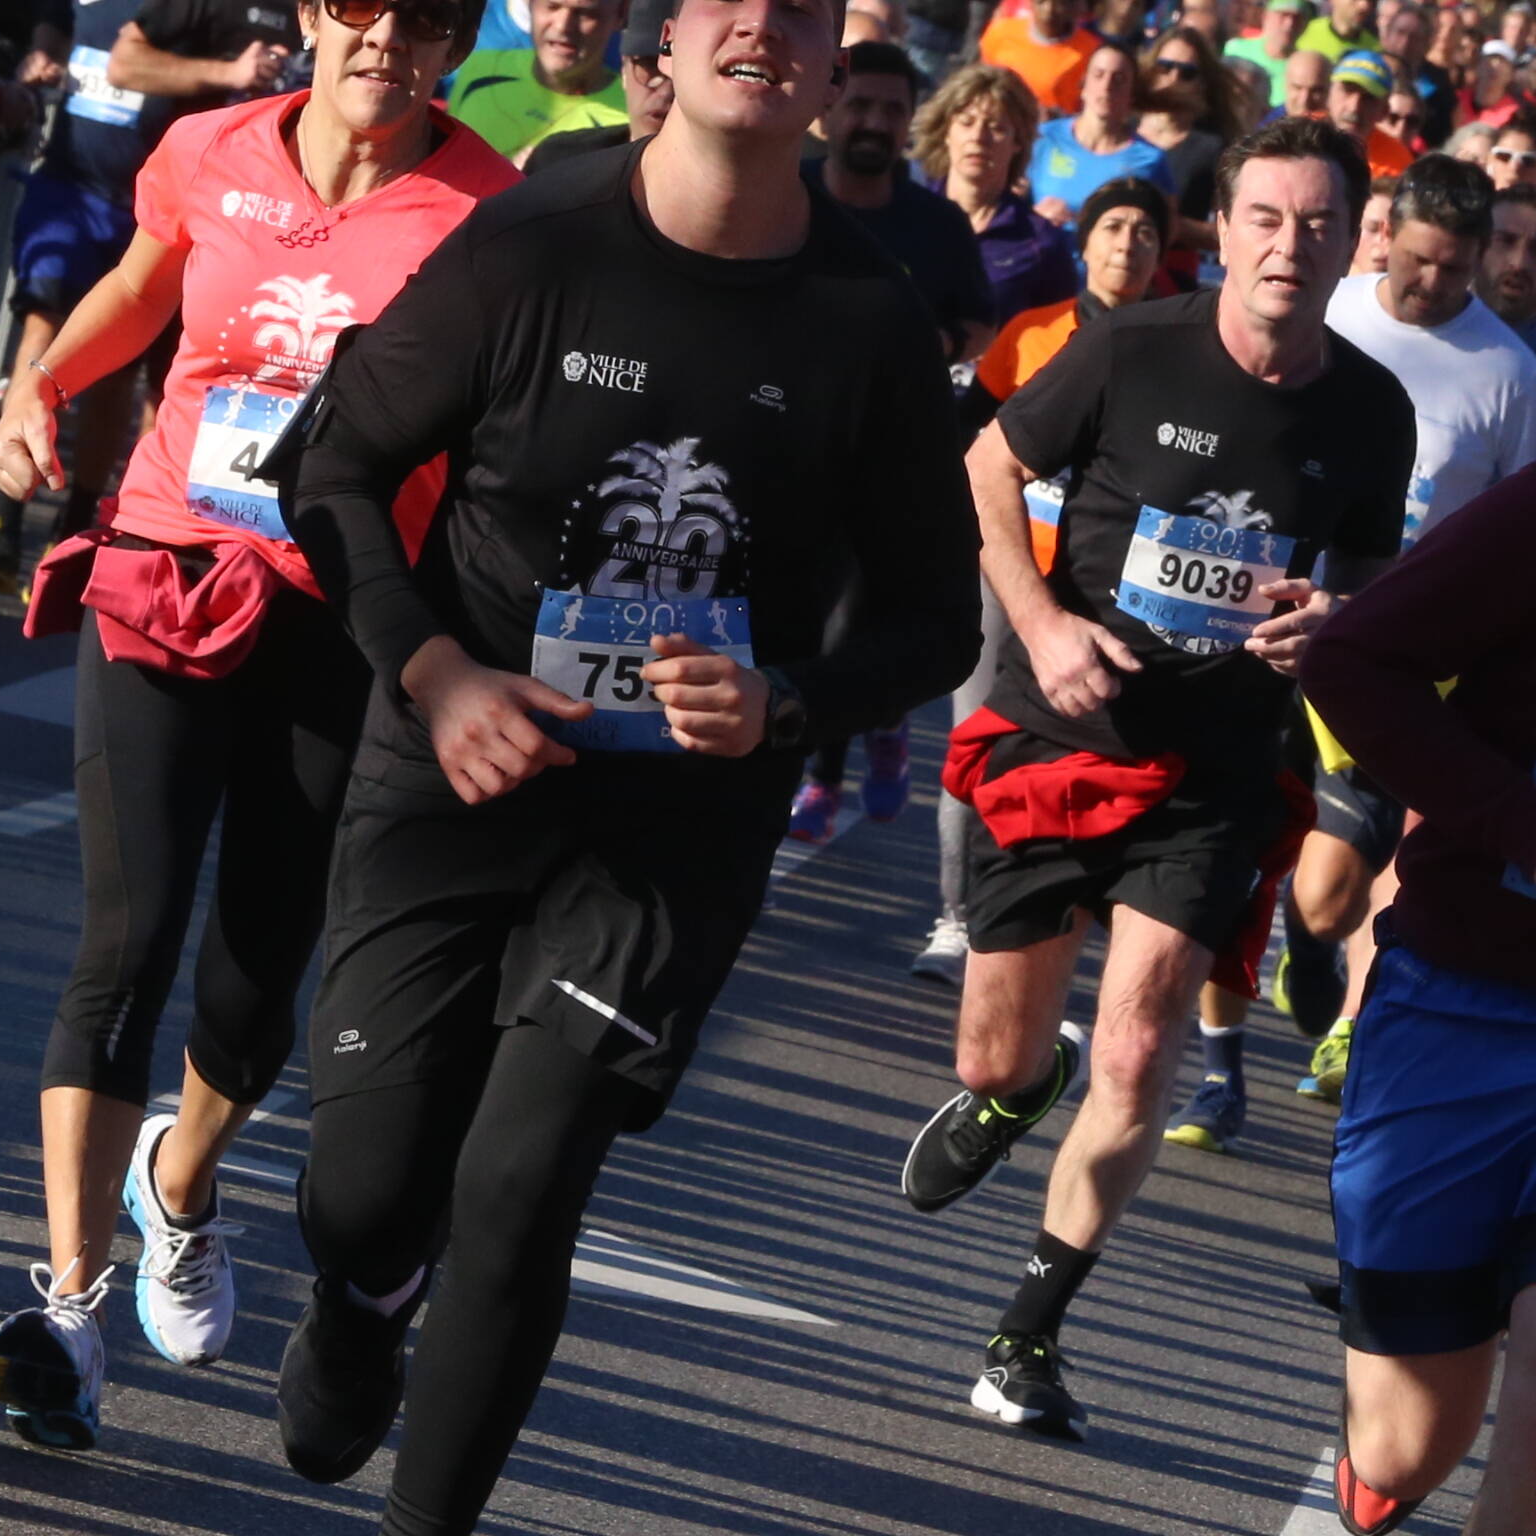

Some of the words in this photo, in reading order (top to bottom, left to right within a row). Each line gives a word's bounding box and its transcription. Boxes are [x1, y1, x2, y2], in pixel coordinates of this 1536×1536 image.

[239, 202, 291, 229] NICE
[244, 191, 273, 209] VILLE
[276, 199, 294, 217] DE
[589, 353, 627, 371] VILLE
[629, 360, 648, 375] DE
[587, 366, 646, 393] NICE
[1174, 435, 1217, 458] NICE
[1178, 425, 1202, 441] VILLE
[1204, 432, 1220, 446] DE
[218, 506, 263, 526] NICE
[611, 541, 721, 570] ANNIVERSAIRE
[1156, 553, 1254, 604] 9039
